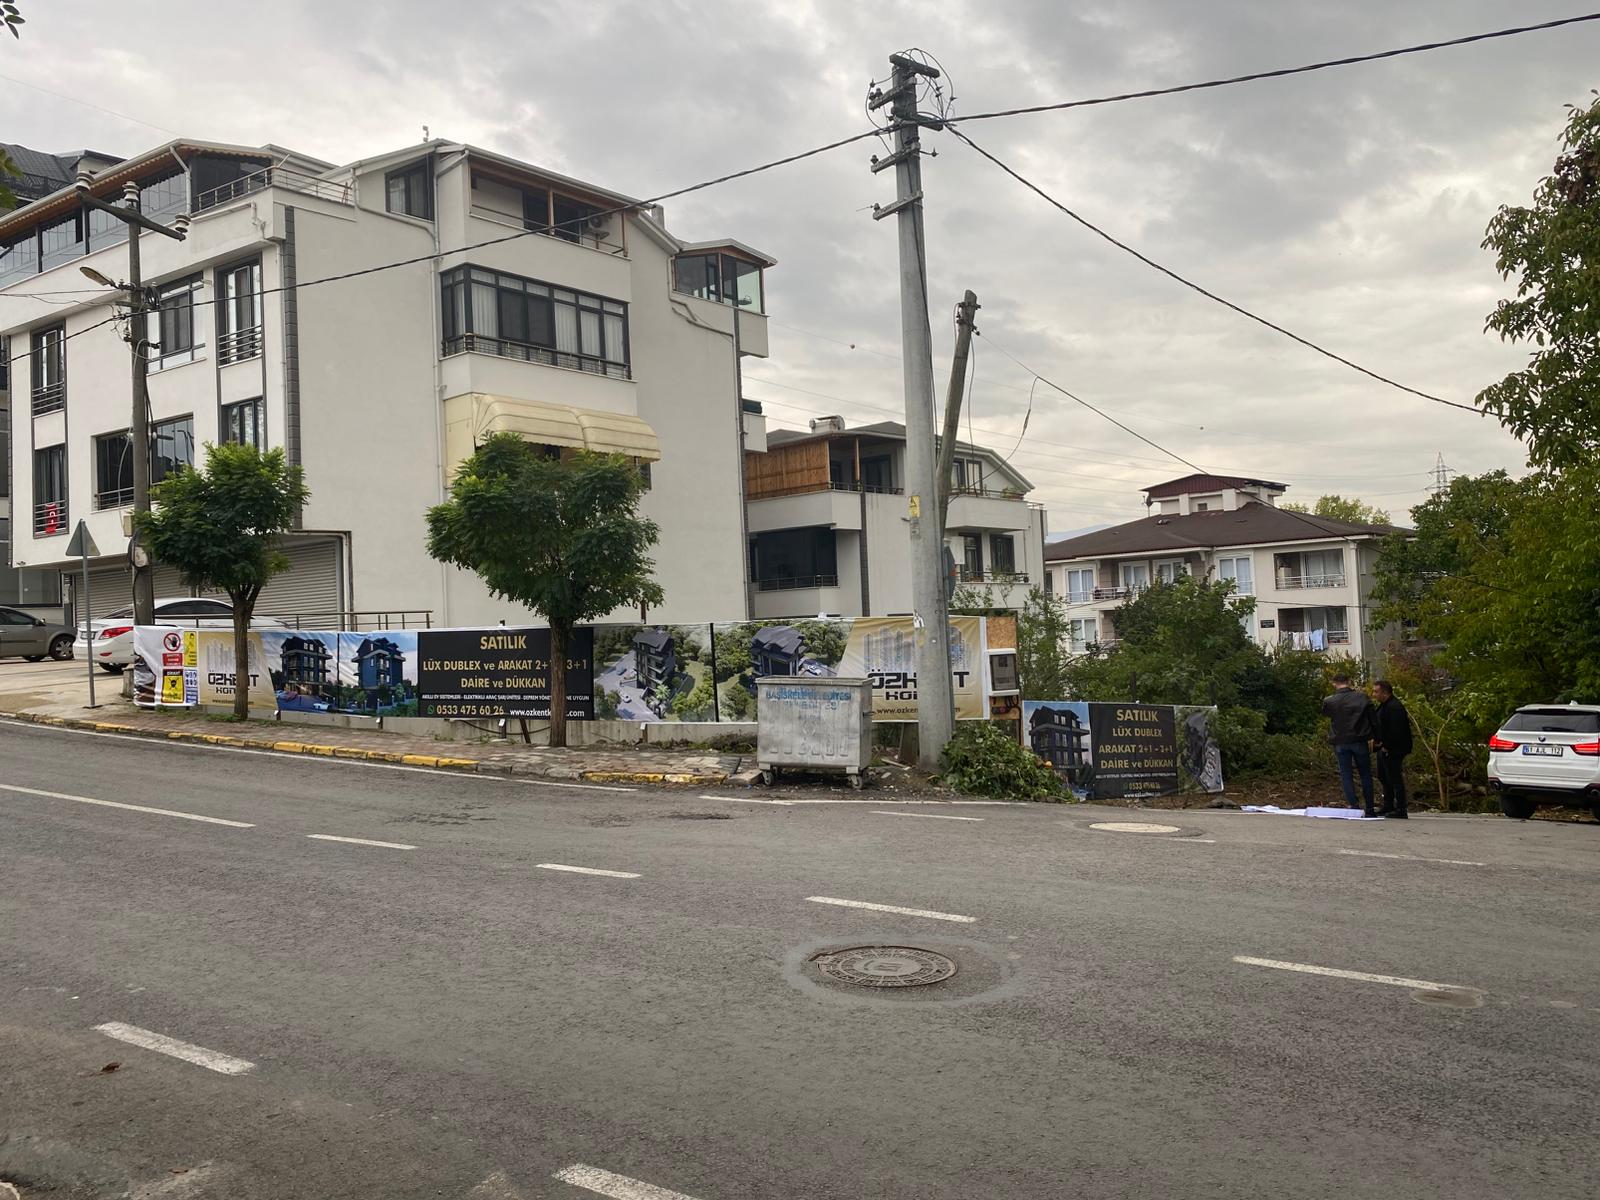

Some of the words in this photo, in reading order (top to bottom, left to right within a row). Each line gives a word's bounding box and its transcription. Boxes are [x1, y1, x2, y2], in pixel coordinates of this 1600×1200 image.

[480, 635, 527, 650] SATILIK
[423, 658, 441, 671] LÜX
[443, 660, 481, 671] DUBLEX
[483, 663, 495, 671] ve
[497, 659, 533, 671] ARAKAT
[566, 659, 588, 670] 3+1
[461, 675, 490, 689] DAİRE
[493, 680, 504, 689] ve
[506, 675, 546, 689] DÜKKAN
[436, 704, 458, 715] 0533
[460, 705, 477, 715] 475
[480, 705, 491, 715] 60
[493, 705, 505, 715] 26
[1116, 709, 1159, 721] SATILIK
[1112, 725, 1132, 737] LÜX
[1134, 727, 1162, 737] DUBLEX
[1098, 744, 1137, 754] ARAKAT
[1101, 757, 1130, 769] DAİRE
[1144, 757, 1174, 768] DÜKKAN
